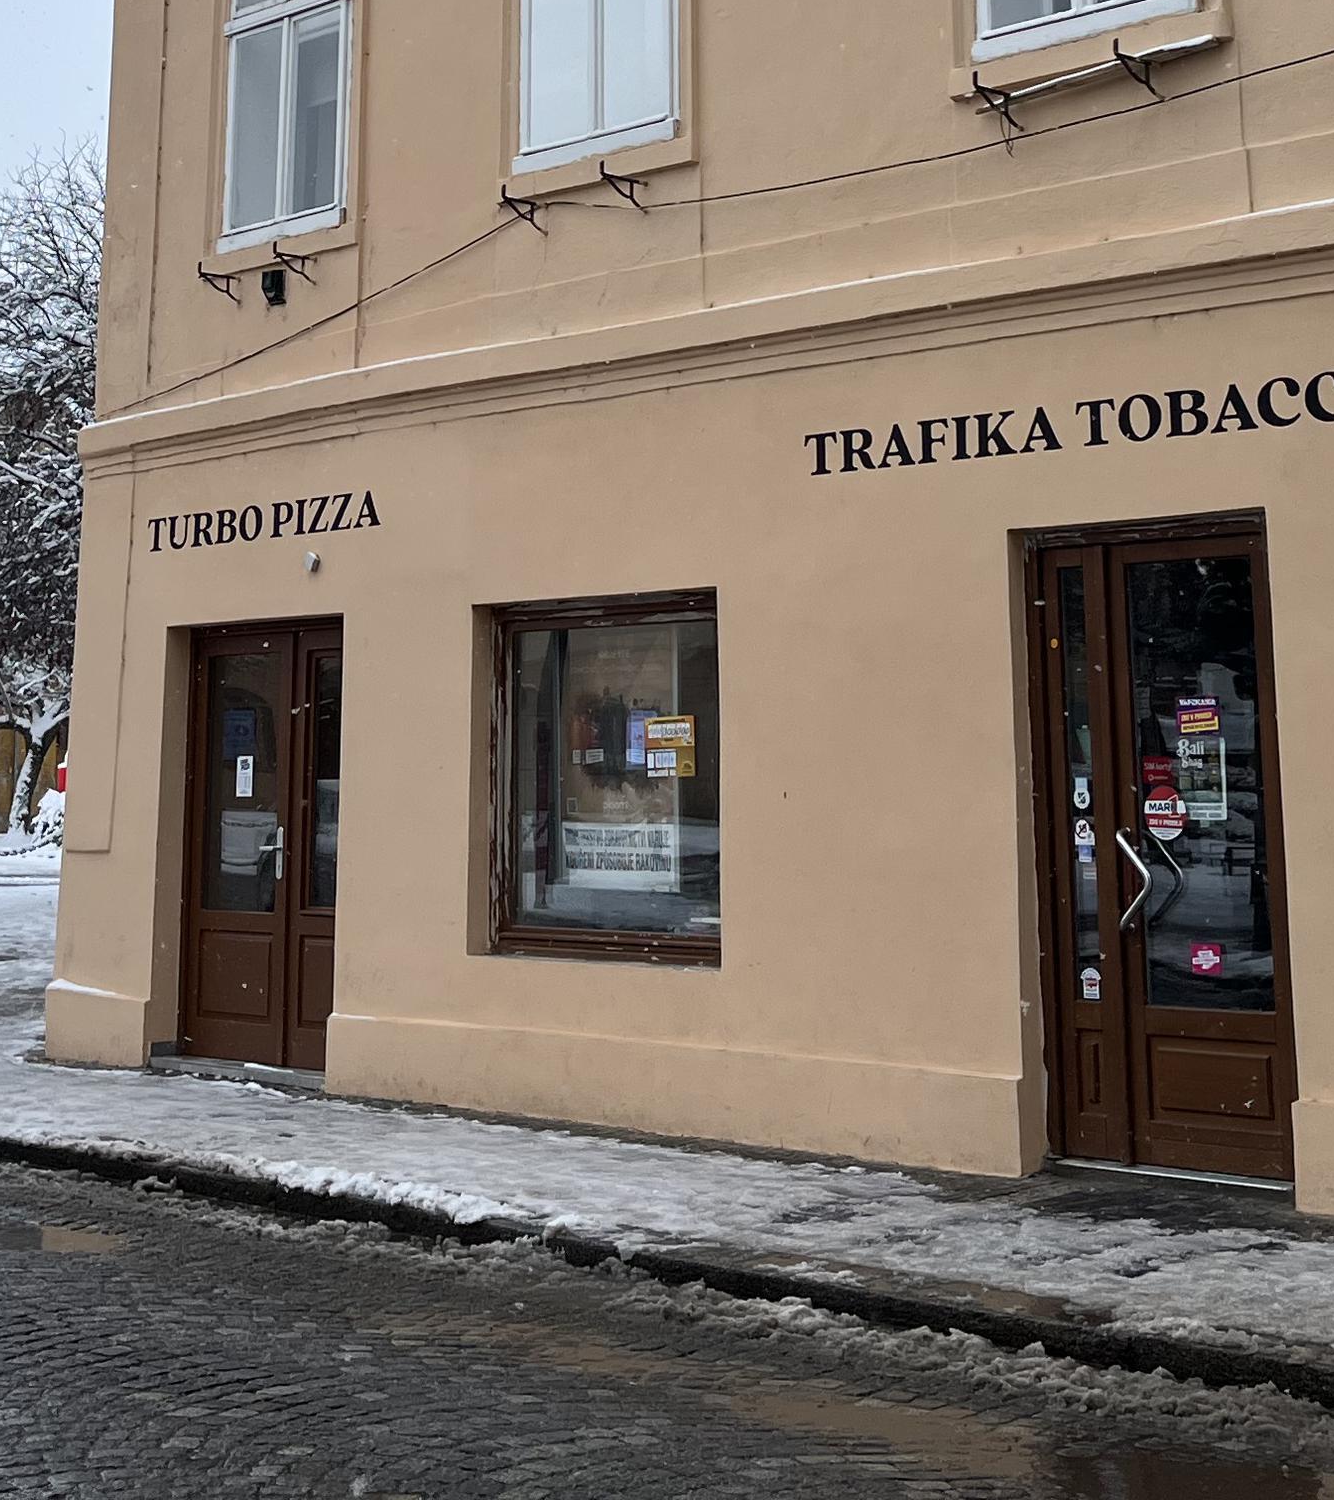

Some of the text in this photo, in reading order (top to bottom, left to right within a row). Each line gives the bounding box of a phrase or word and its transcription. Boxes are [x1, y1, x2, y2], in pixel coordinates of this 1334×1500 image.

[803, 406, 1063, 476] TRAFIKA
[148, 490, 381, 553] TURBO PIZZA
[1176, 738, 1205, 757] Bali
